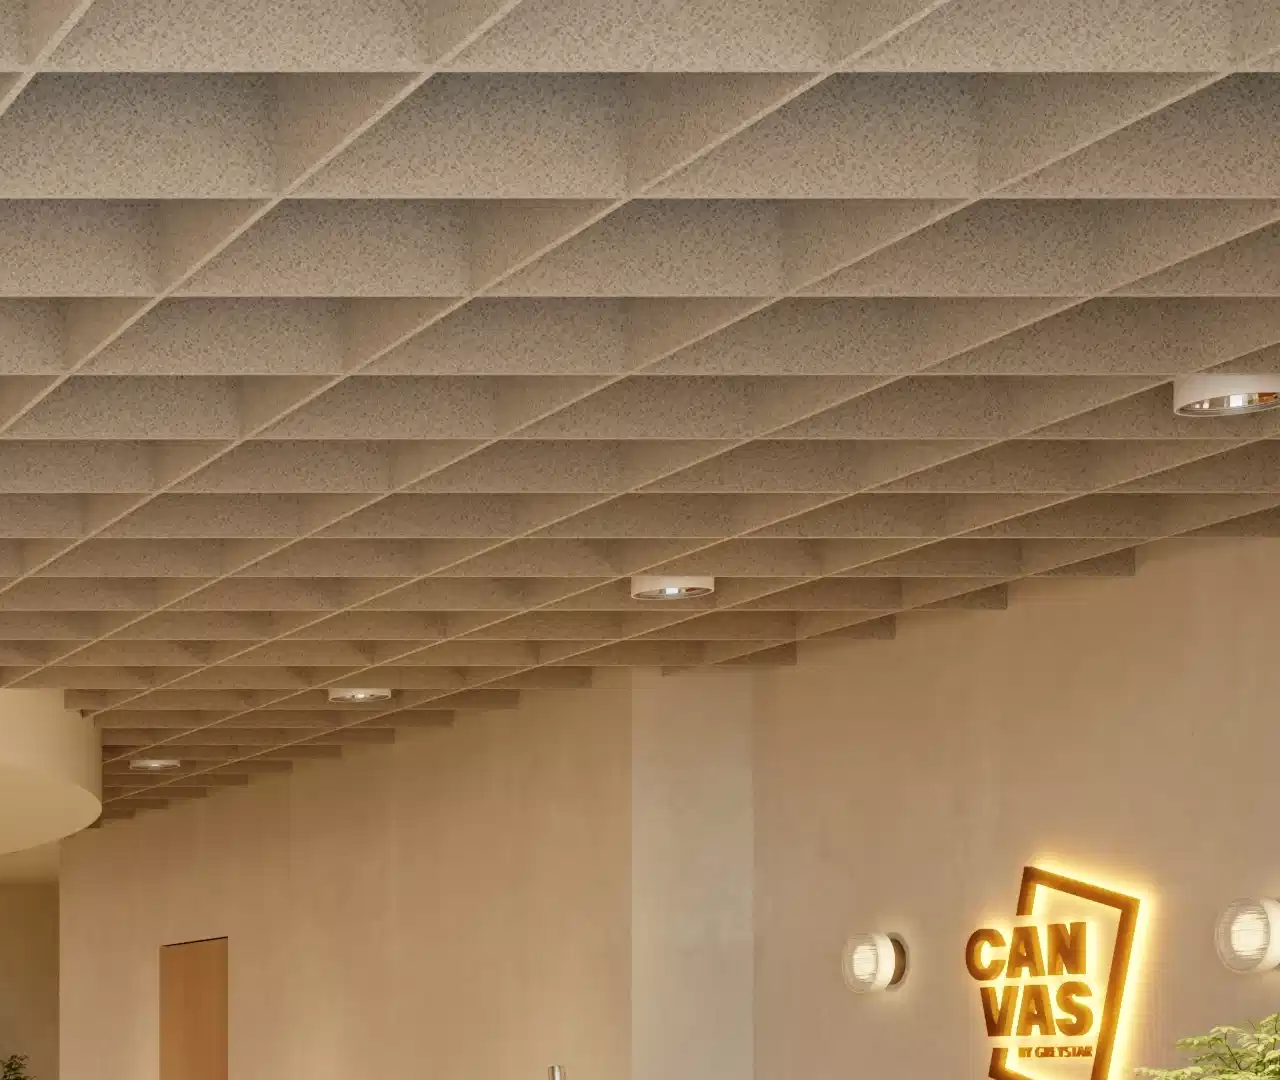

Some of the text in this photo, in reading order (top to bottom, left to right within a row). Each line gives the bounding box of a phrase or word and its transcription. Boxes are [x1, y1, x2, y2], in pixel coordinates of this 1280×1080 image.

[965, 921, 1087, 981] CAN
[980, 981, 1094, 1037] VAS
[1018, 1046, 1033, 1058] BY
